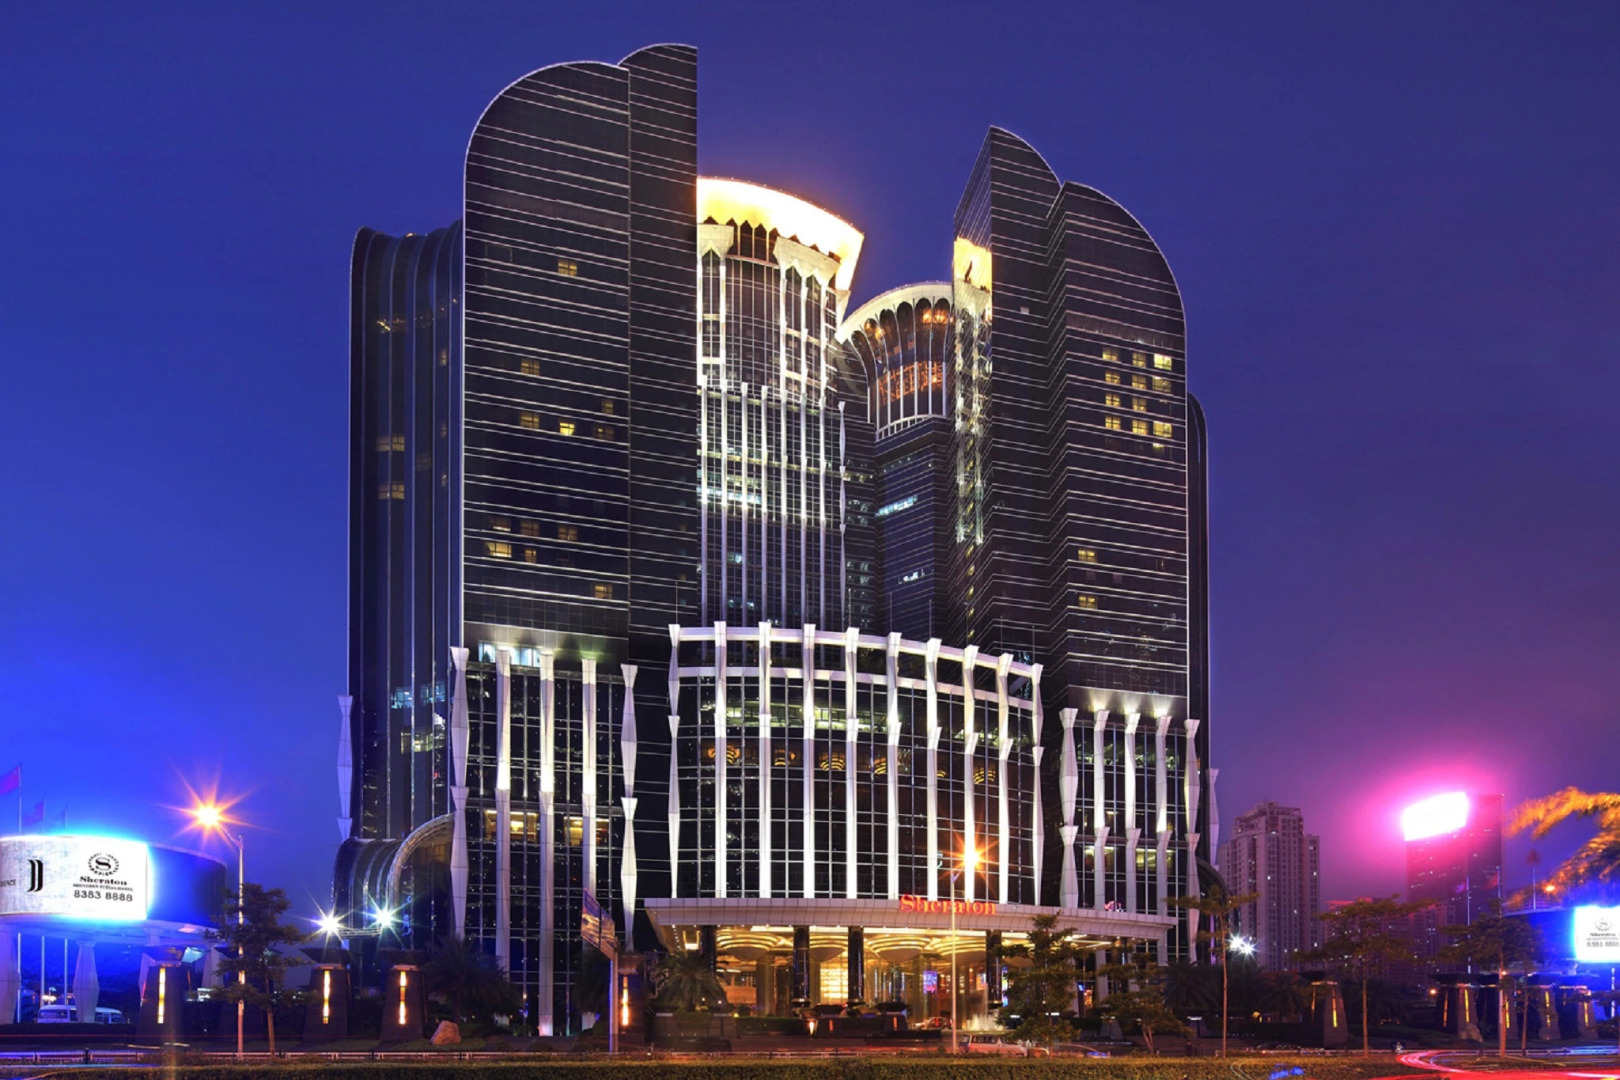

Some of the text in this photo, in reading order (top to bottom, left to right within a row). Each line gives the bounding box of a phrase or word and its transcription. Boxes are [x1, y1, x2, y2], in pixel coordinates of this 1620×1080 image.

[80, 876, 127, 886] Sheraton
[74, 889, 133, 902] 8383 8888
[900, 894, 996, 915] Sheraton
